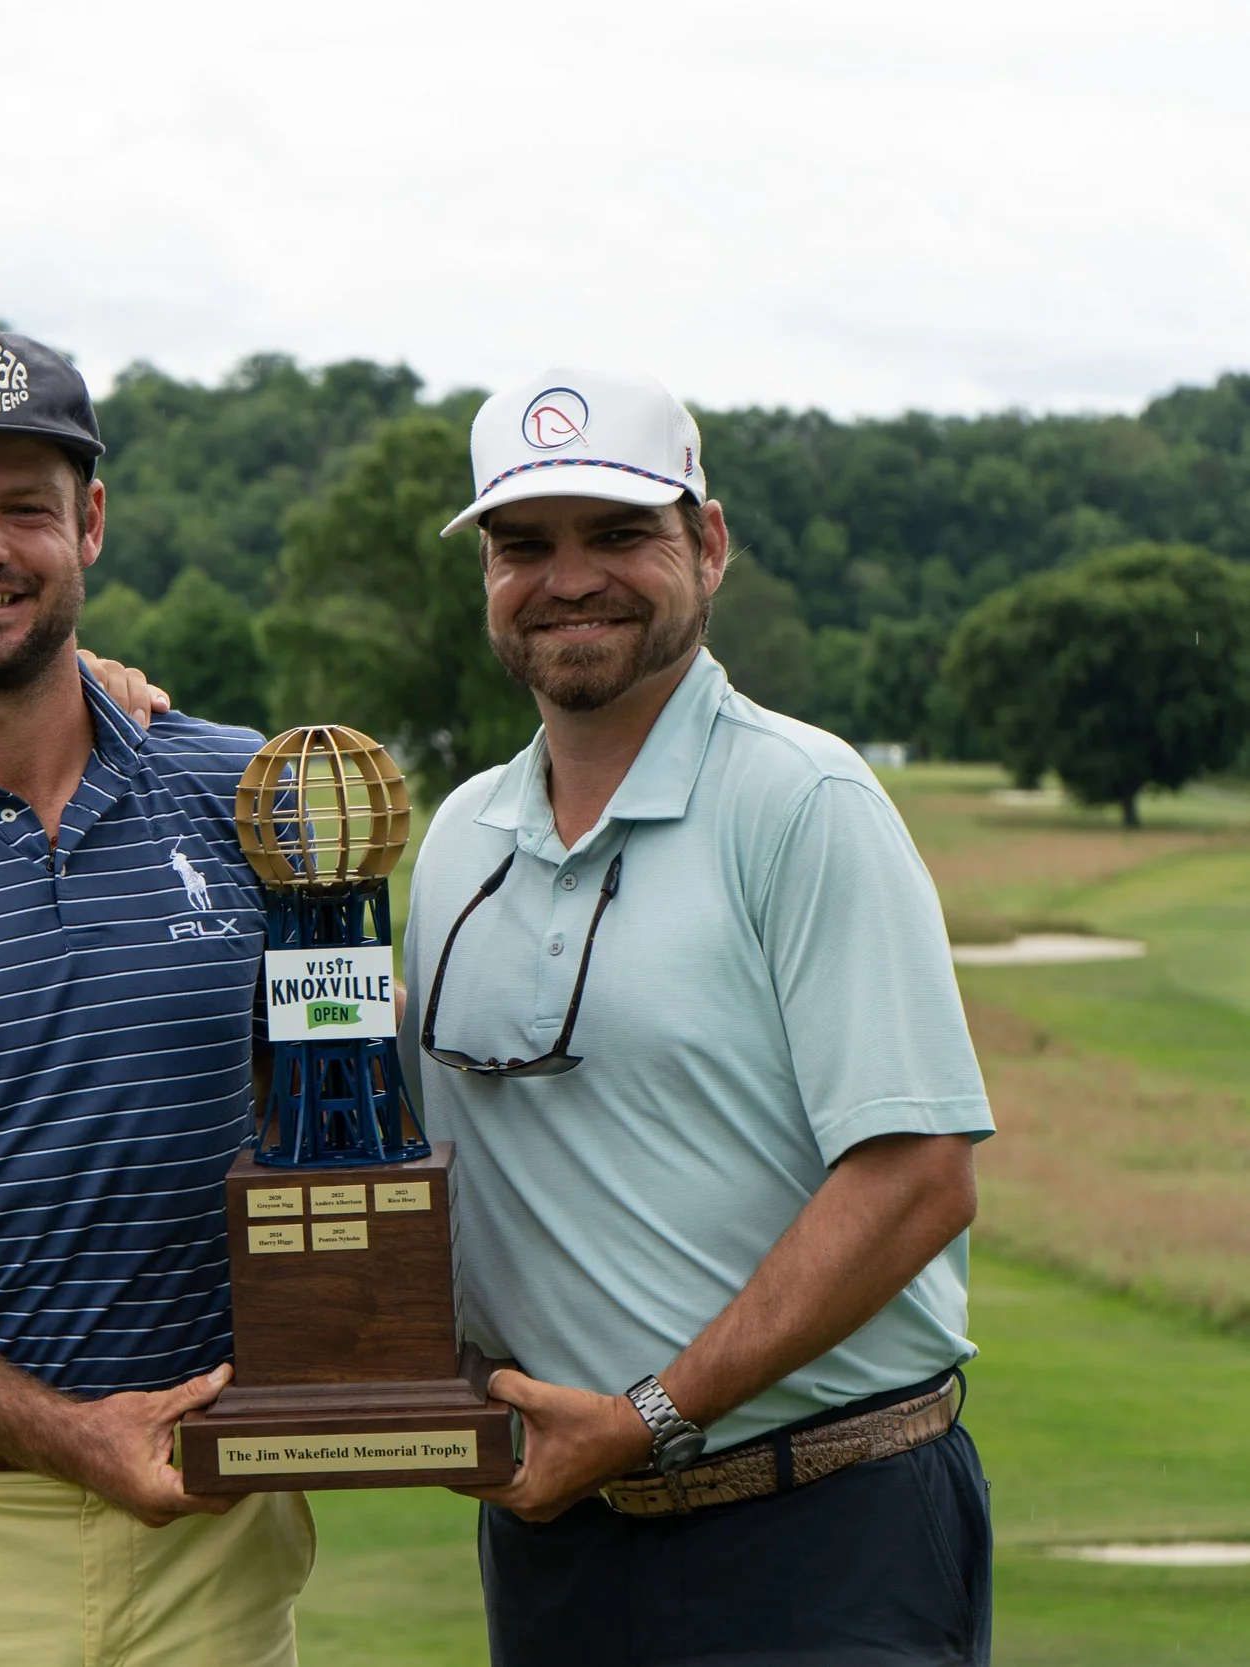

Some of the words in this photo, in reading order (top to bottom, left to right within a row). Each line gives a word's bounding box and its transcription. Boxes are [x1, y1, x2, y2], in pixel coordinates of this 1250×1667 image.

[168, 918, 240, 940] RLX
[306, 957, 353, 975] VISIT
[271, 975, 390, 1006] KNOXVILLE
[313, 1006, 349, 1022] OPEN
[226, 1450, 252, 1462] The
[255, 1449, 280, 1462] Jim
[284, 1447, 349, 1460] Wakefield
[353, 1445, 417, 1458] Memorial
[421, 1444, 468, 1458] Trophy
